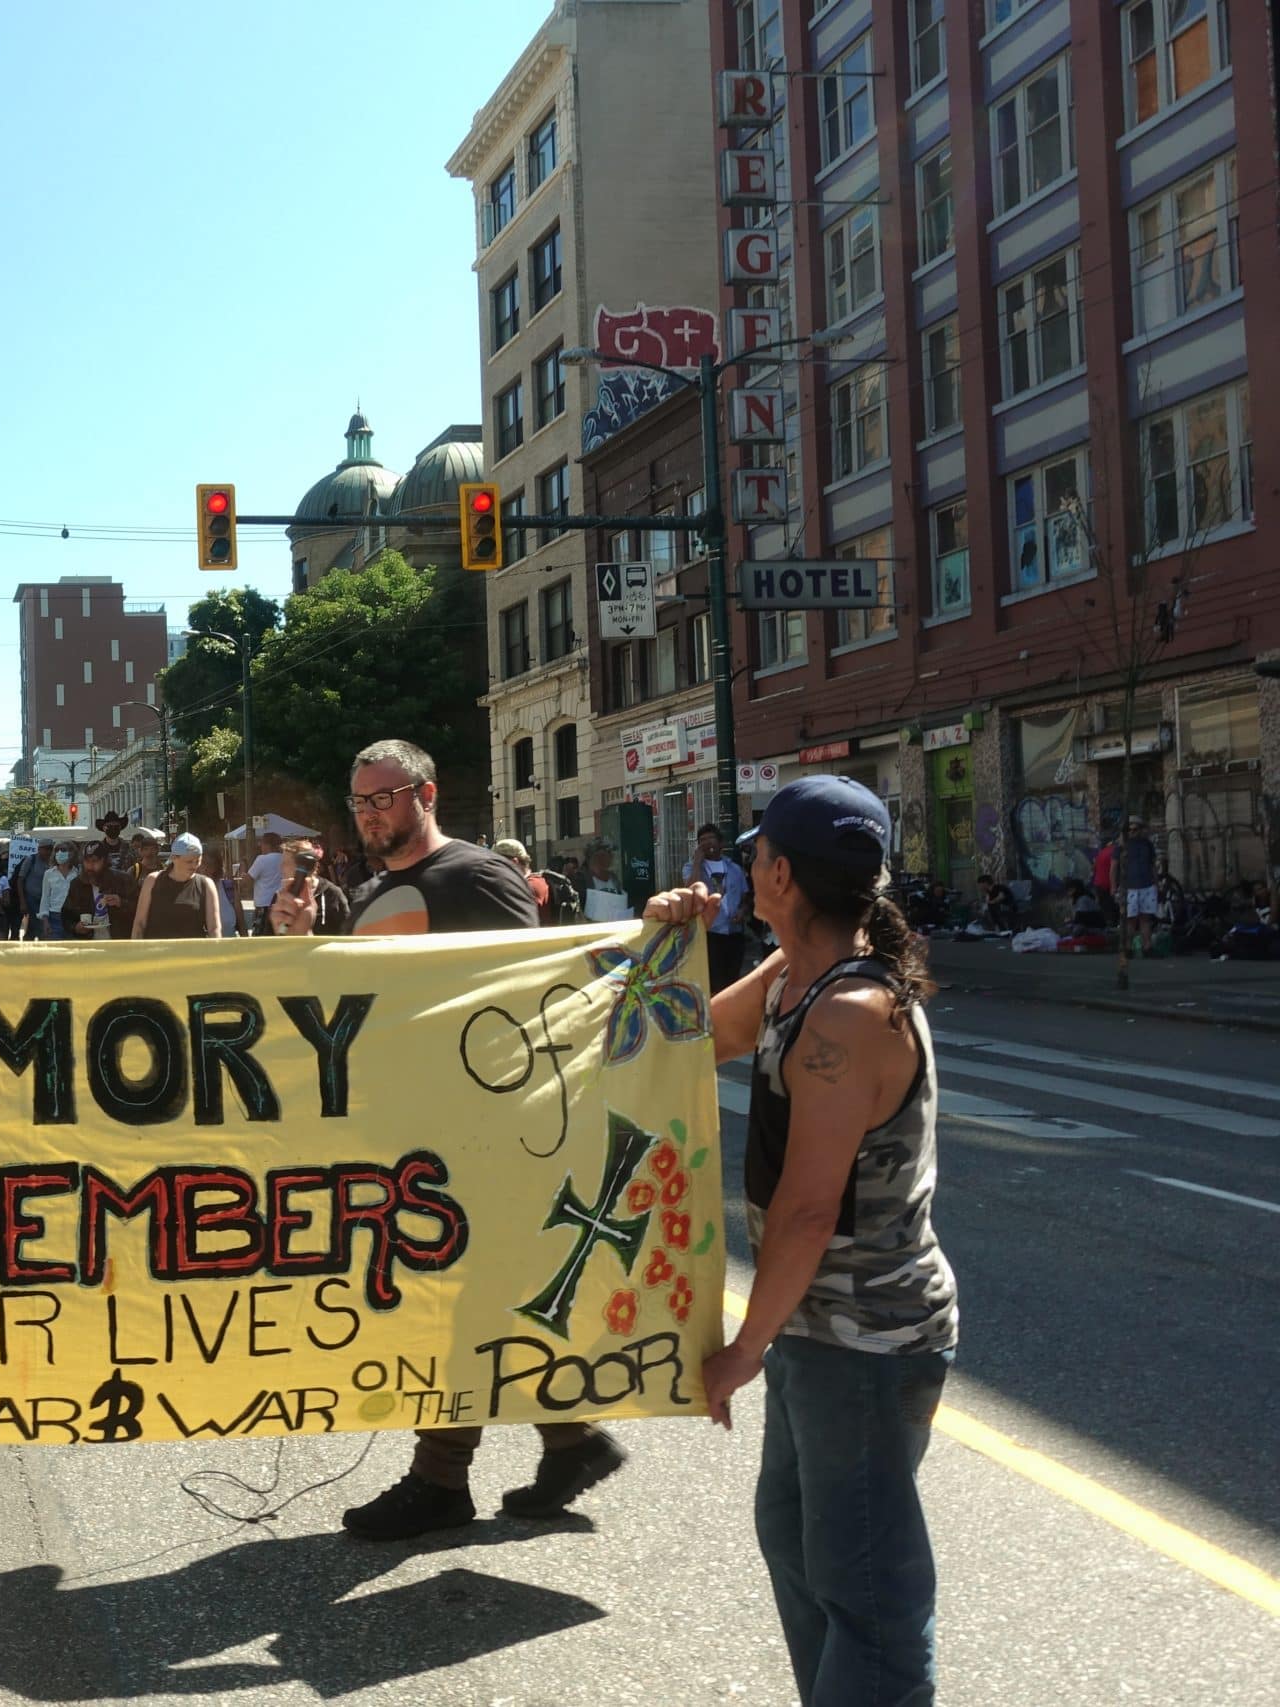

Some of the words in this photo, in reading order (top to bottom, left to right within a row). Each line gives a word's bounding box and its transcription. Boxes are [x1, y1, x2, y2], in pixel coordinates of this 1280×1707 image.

[733, 76, 782, 515] REGENT
[753, 568, 873, 599] HOTEL
[109, 1278, 361, 1364] LIVES
[157, 1387, 339, 1434] WAR
[352, 1355, 437, 1392] ON
[403, 1389, 477, 1425] THE
